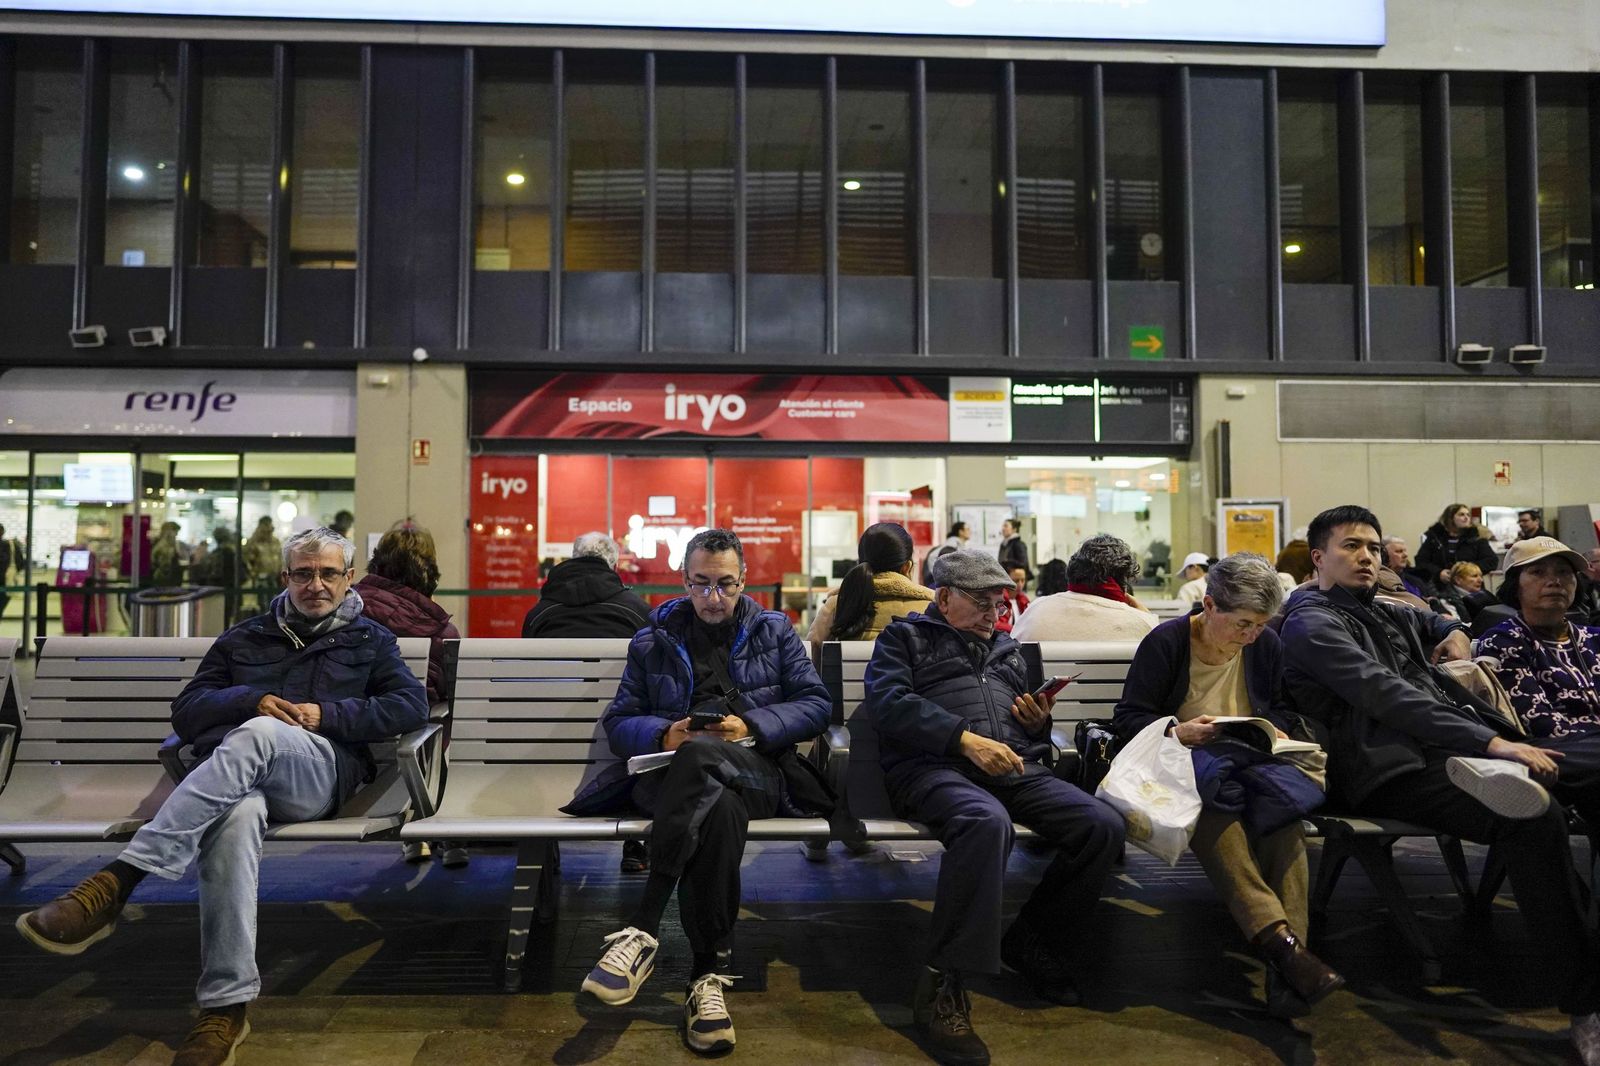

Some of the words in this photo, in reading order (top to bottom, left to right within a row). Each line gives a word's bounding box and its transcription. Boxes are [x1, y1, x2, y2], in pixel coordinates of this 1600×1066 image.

[125, 380, 237, 422] renfe
[1100, 385, 1118, 395] Jefe
[1119, 385, 1131, 395] de
[1132, 386, 1168, 396] estación
[568, 397, 633, 416] Espacio
[664, 383, 747, 431] iryo
[780, 399, 821, 409] Atención
[822, 399, 832, 409] al
[833, 399, 865, 409] cliente
[787, 409, 833, 418] Customer
[834, 410, 856, 418] care
[482, 471, 528, 499] iryo
[628, 514, 711, 571] iry
